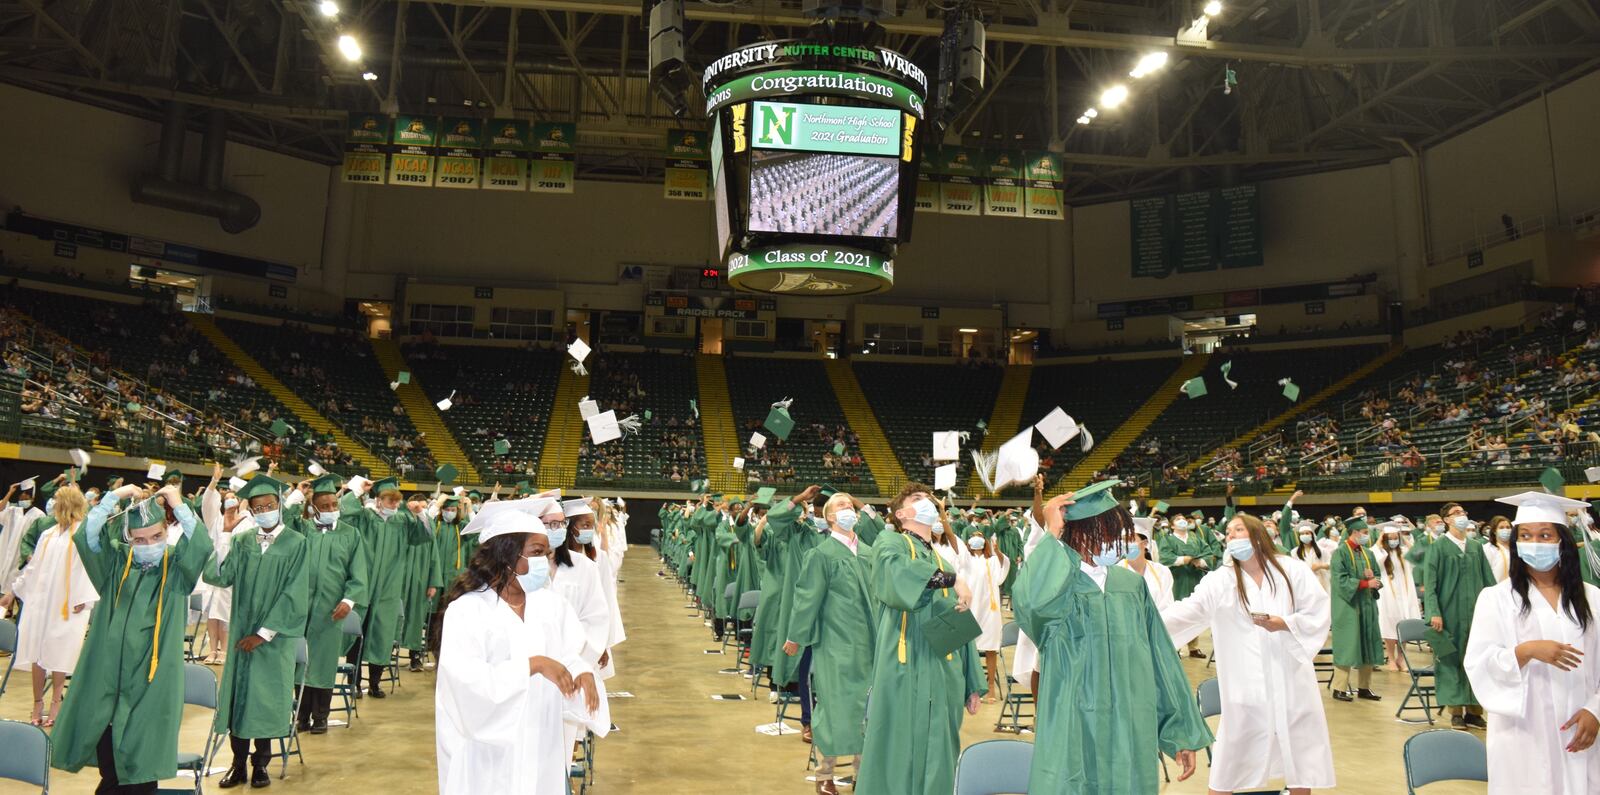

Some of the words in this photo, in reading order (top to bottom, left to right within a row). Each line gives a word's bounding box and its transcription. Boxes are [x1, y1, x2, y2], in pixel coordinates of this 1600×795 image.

[784, 44, 829, 56] NUTTER
[833, 46, 876, 61] CENTER
[704, 44, 778, 83] UNIVERSITY
[881, 49, 925, 86] WRIGHT
[751, 73, 894, 98] Congratulations
[803, 113, 847, 127] Northmont
[848, 114, 868, 131] High
[869, 117, 896, 129] School
[811, 130, 834, 142] 2021
[836, 130, 888, 145] Graduation
[396, 159, 428, 175] NCAA
[947, 203, 973, 211] 2017
[764, 249, 806, 264] Class
[810, 250, 829, 263] of
[834, 251, 871, 268] 2021
[677, 307, 715, 318] RAIDER
[718, 309, 746, 318] PACK
